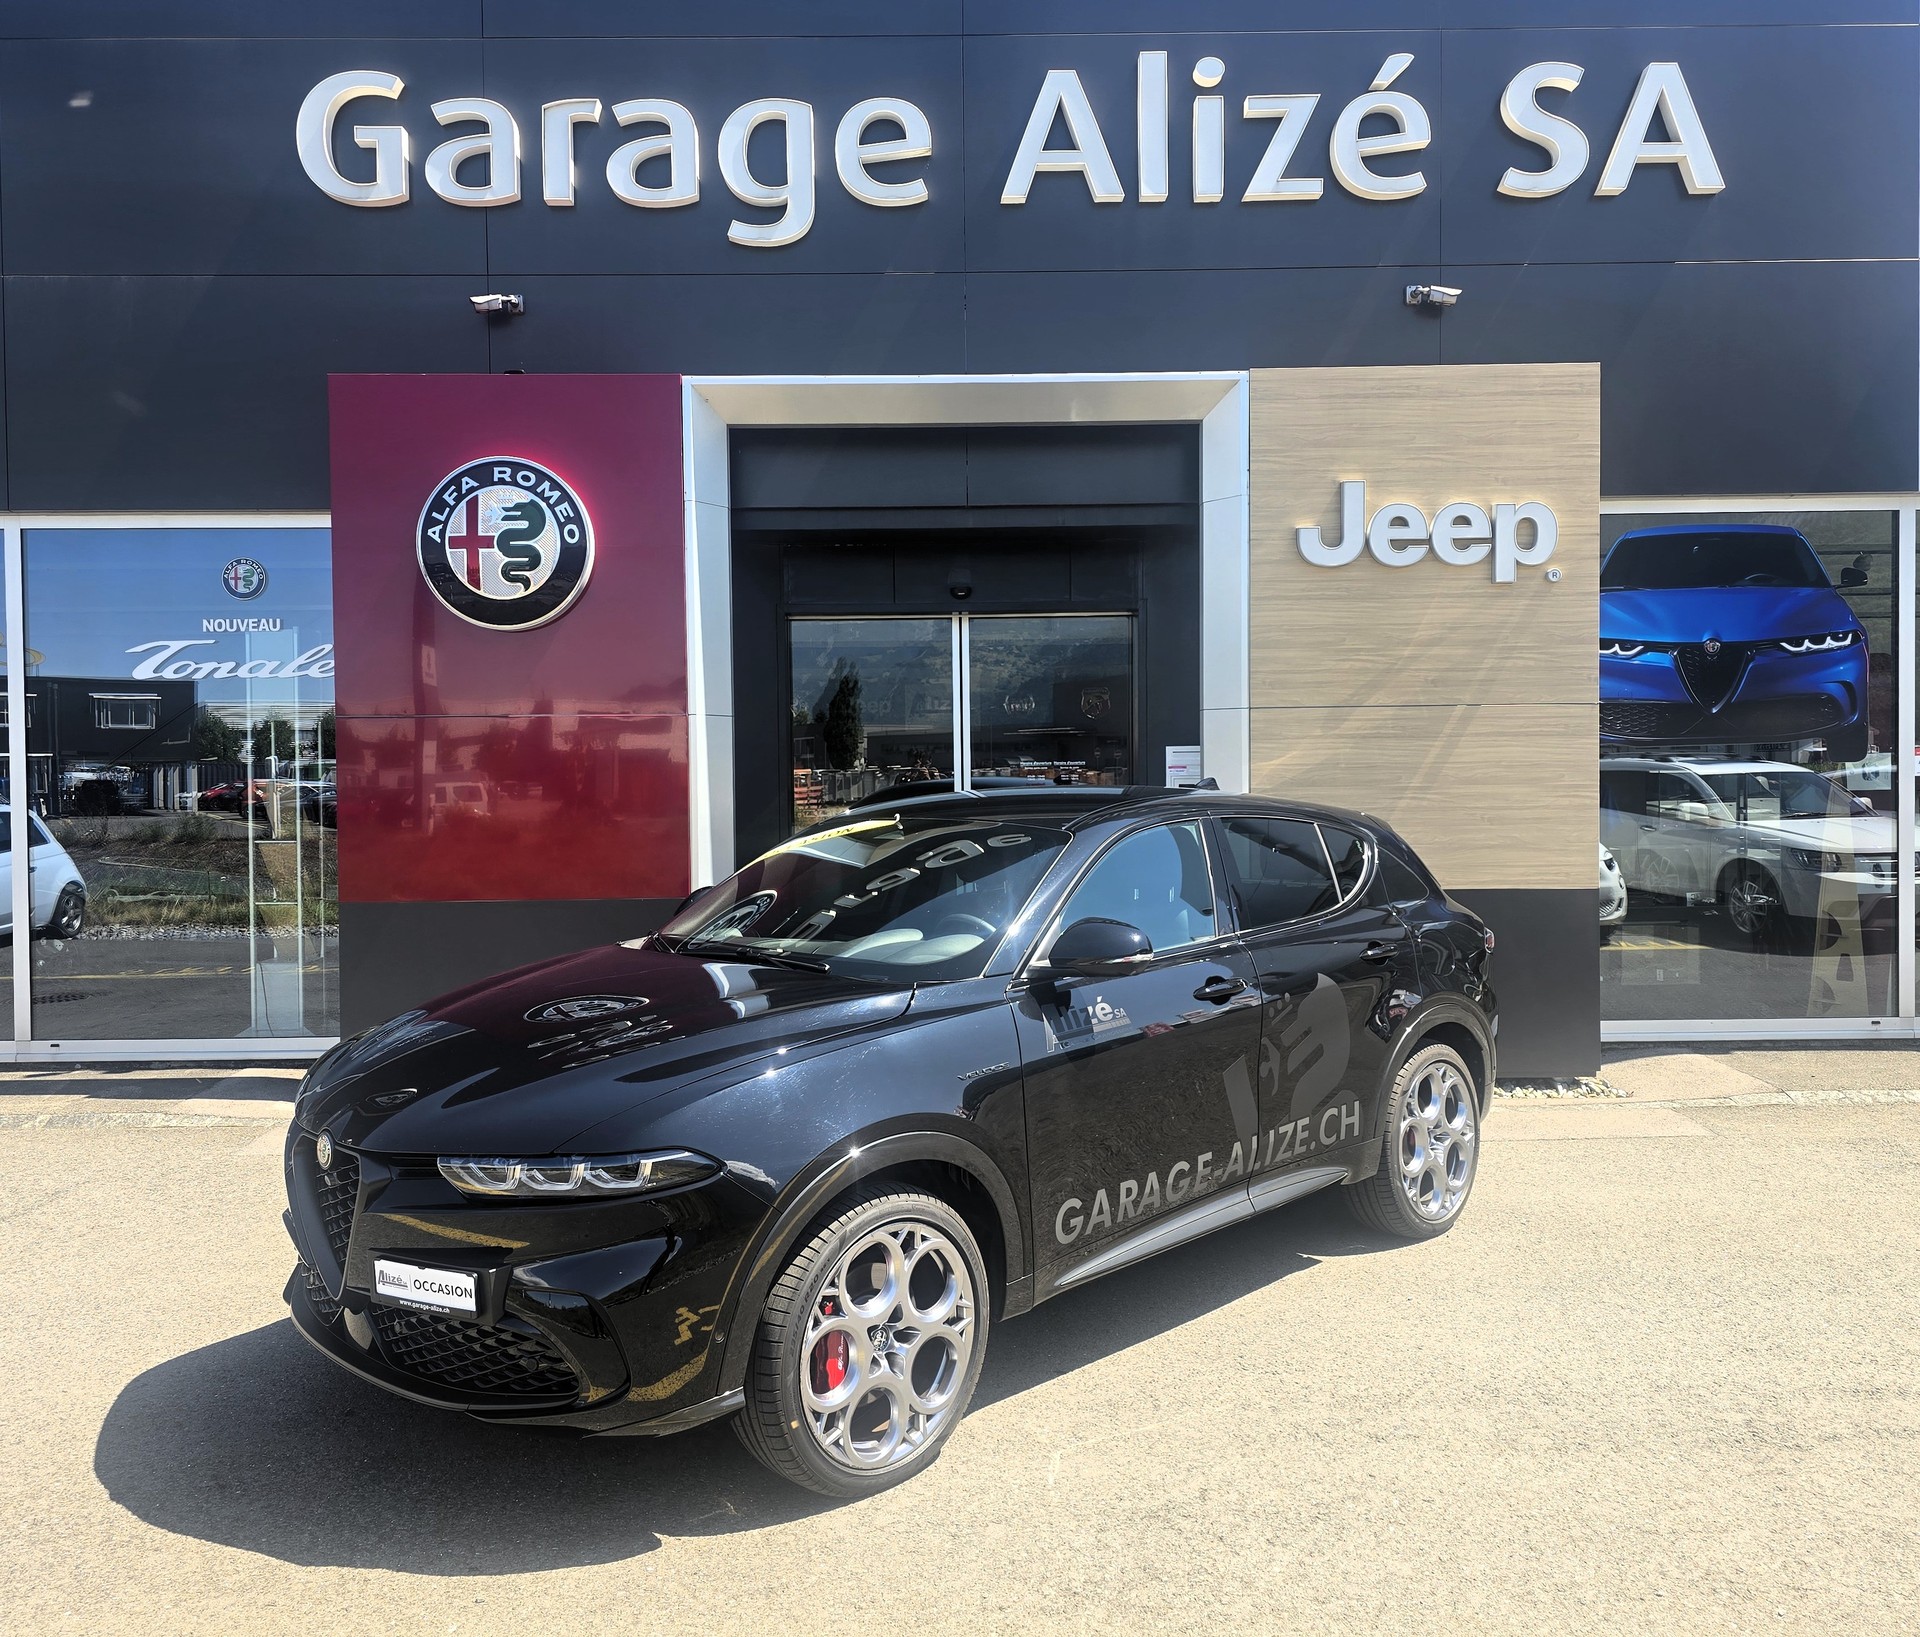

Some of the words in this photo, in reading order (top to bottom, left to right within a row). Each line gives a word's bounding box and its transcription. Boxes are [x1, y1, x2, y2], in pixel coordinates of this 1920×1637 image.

[296, 69, 933, 248] Garage
[1000, 50, 1432, 204] Alizé
[1496, 61, 1726, 198] SA
[427, 475, 480, 544] ALFA
[493, 466, 580, 545] ROMEO
[1296, 479, 1559, 584] Jeep
[223, 561, 238, 579] ALFA
[240, 559, 264, 580] ROMEO
[202, 618, 281, 632] NOUVEAU
[125, 639, 335, 680] Tonale
[1041, 995, 1114, 1054] Alizé
[1114, 1007, 1127, 1019] SA
[1055, 1099, 1361, 1245] GARAGE-ALIZE.CH
[378, 1269, 403, 1285] Alizé
[413, 1278, 473, 1299] OCCASION
